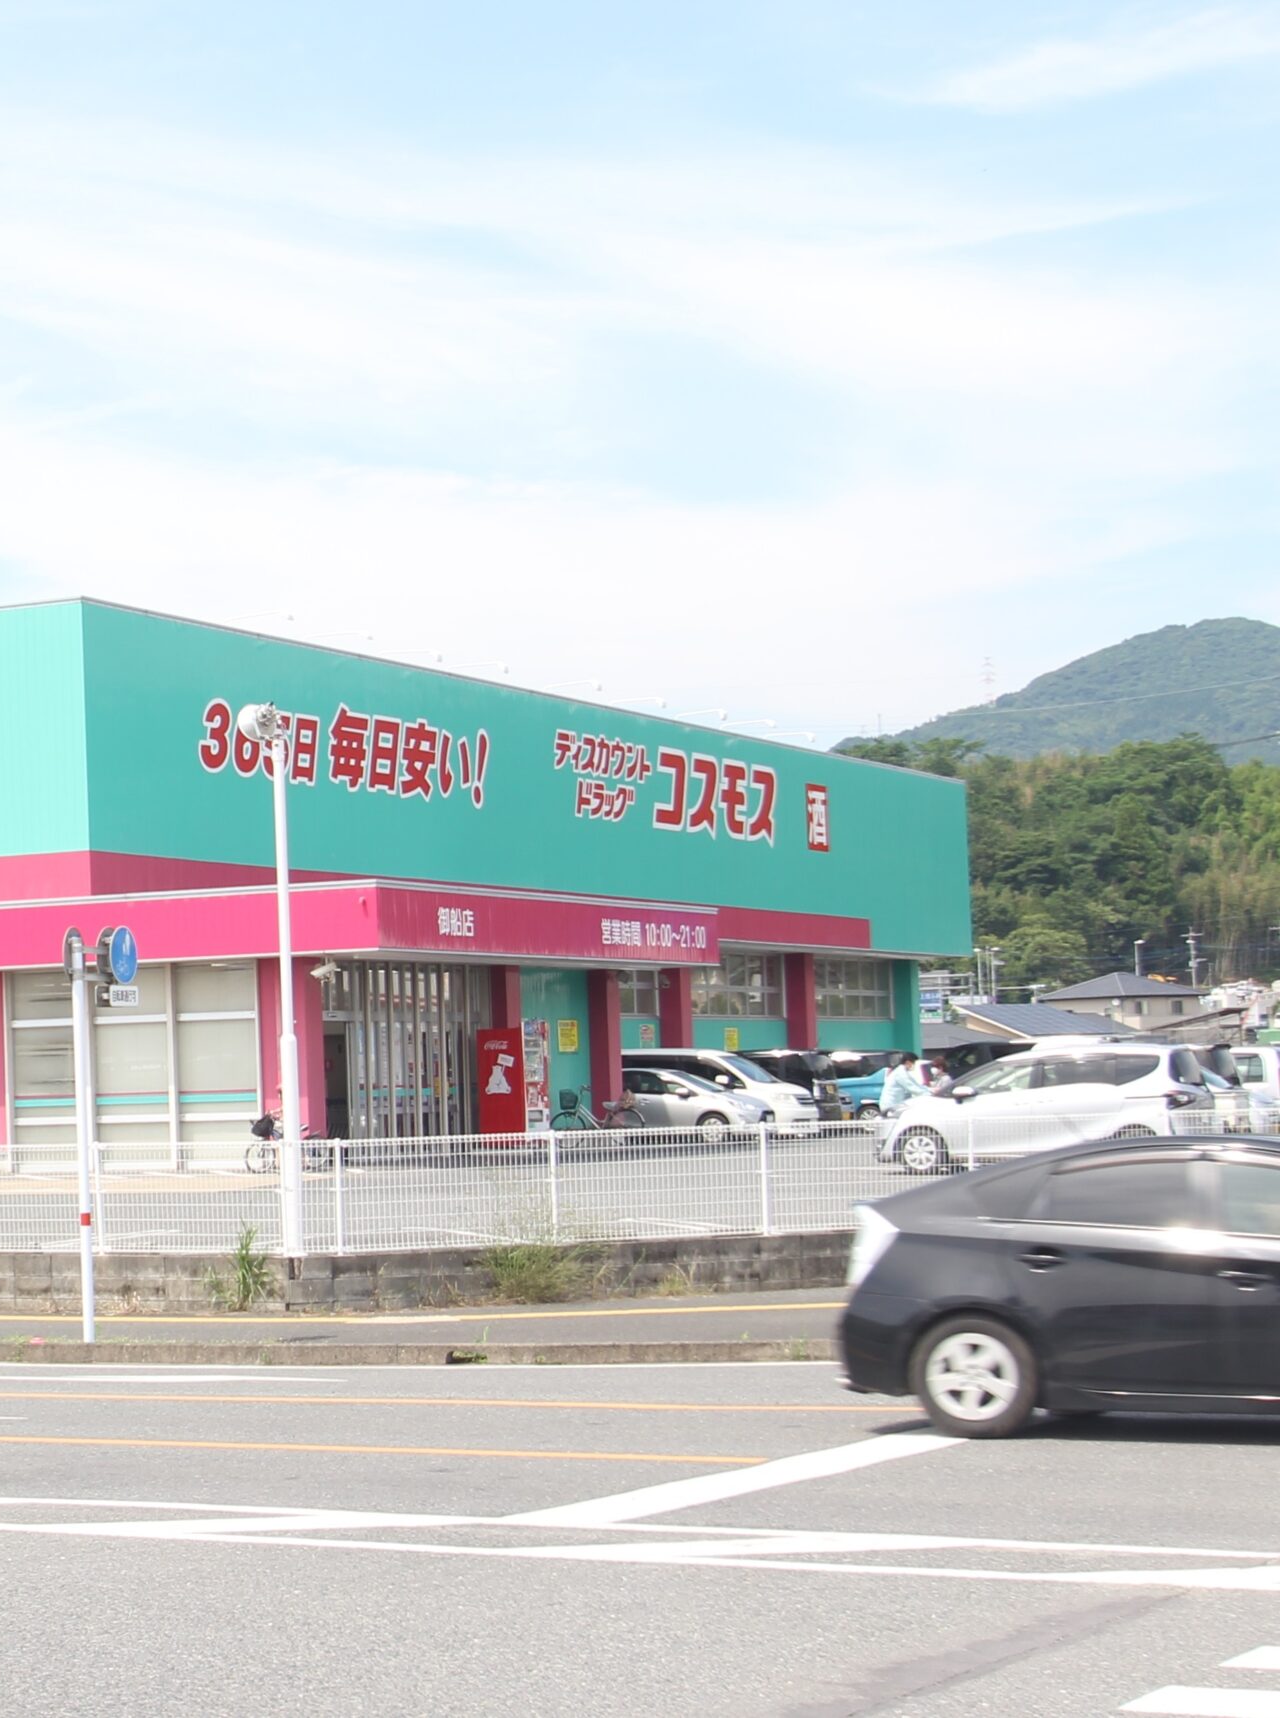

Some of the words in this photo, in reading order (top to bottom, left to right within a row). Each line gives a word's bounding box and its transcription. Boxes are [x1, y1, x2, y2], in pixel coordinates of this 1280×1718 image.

[554, 729, 652, 783] ディスカウント
[575, 778, 635, 822] ドラッグ
[652, 745, 776, 848] コスモス
[807, 790, 828, 846] 酒
[437, 906, 474, 937] 御船店
[601, 918, 641, 947] 営業時間
